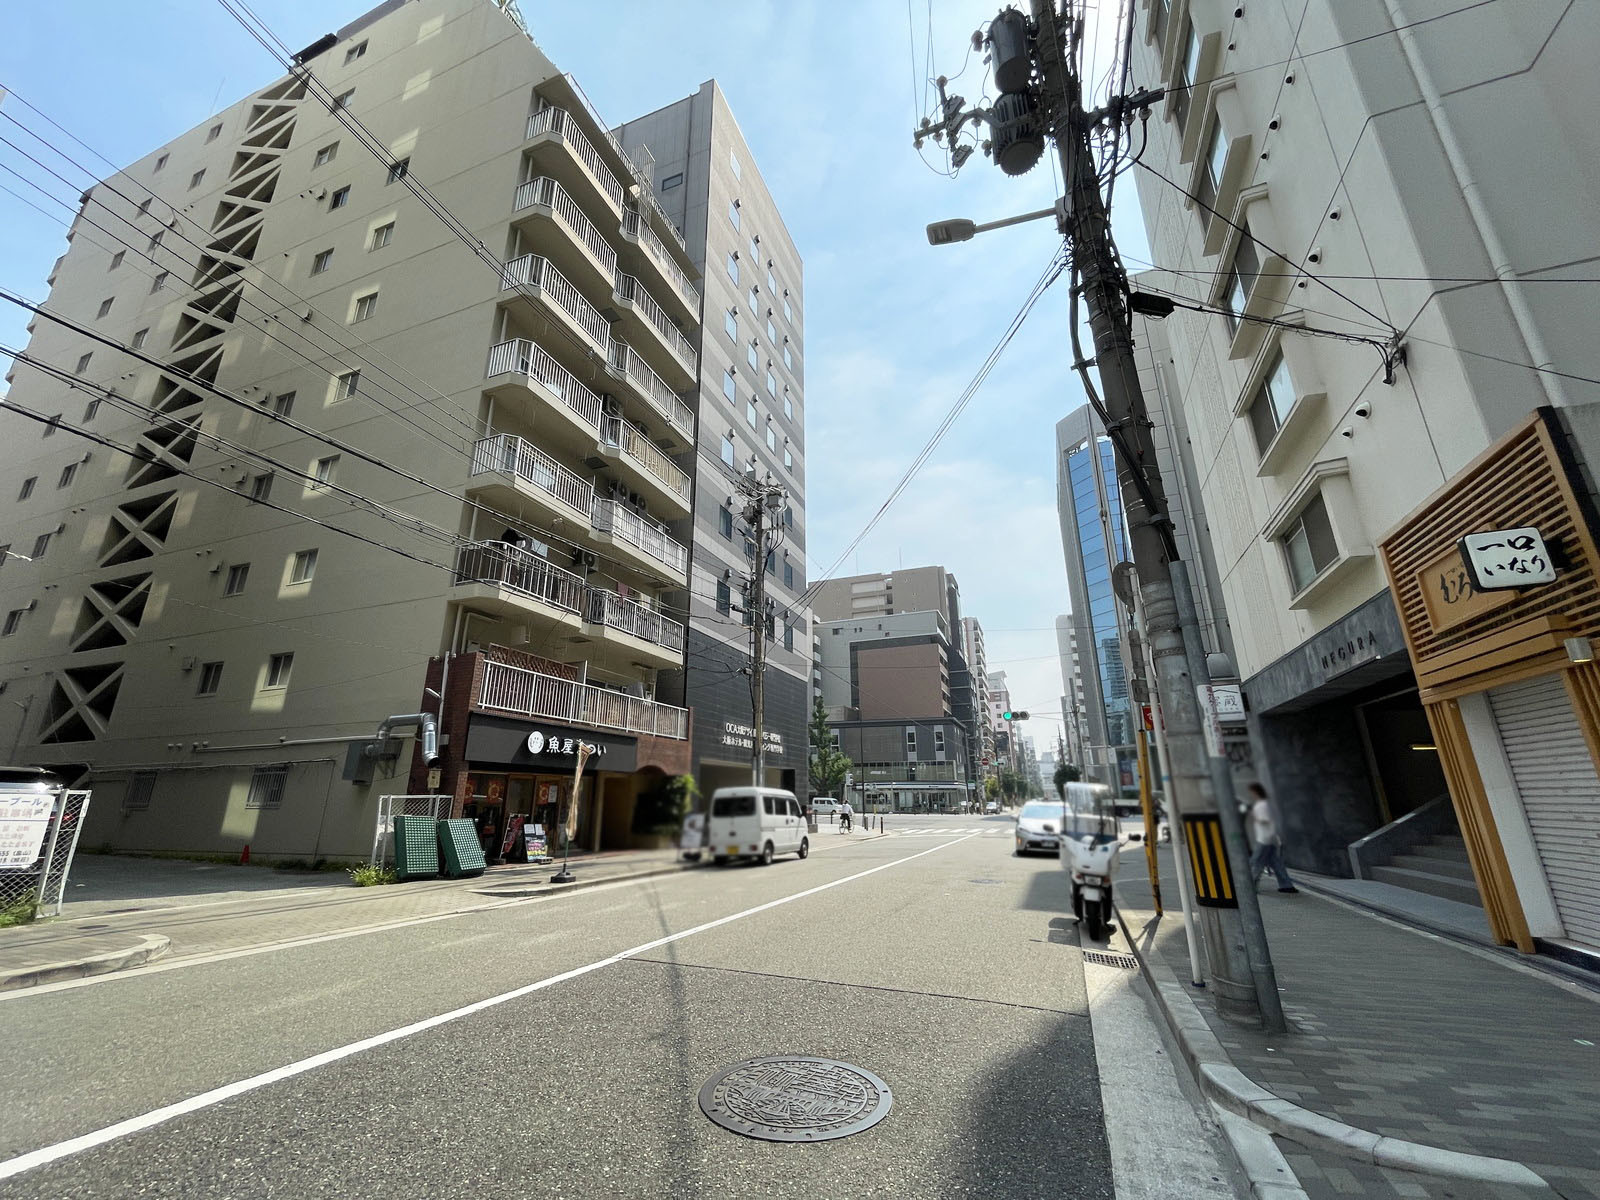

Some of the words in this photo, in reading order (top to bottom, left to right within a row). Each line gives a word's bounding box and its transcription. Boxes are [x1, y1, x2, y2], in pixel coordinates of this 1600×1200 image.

[1476, 535, 1536, 552] 一口
[1483, 554, 1546, 576] いなり
[546, 735, 607, 757] 魚屋つい
